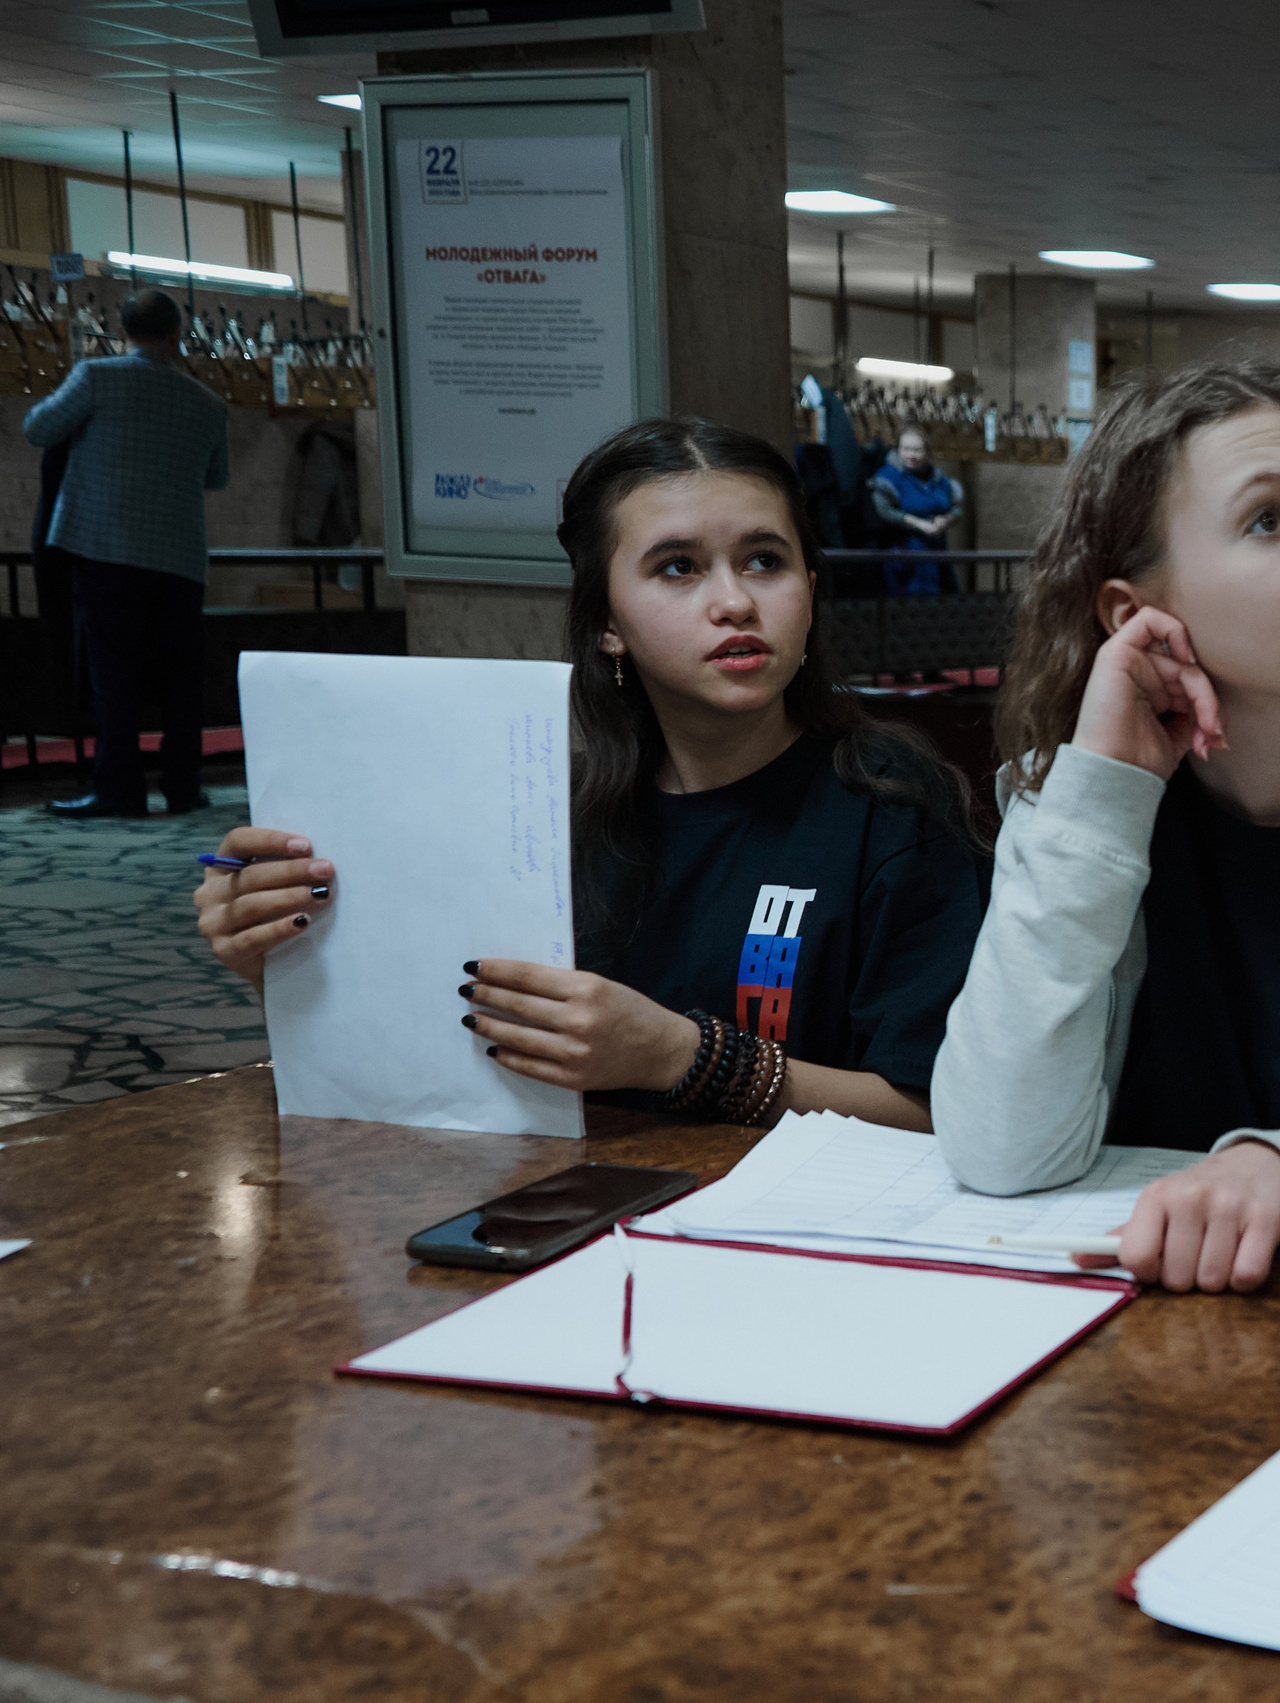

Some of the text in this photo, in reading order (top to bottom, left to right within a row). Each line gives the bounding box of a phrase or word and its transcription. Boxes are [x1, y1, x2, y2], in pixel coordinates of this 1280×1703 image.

[425, 146, 457, 175] 22
[425, 244, 597, 264] МОЛОДЕЖНЫЙ ФОРУМ
[748, 884, 817, 939] ОТ
[738, 934, 802, 988] ВА
